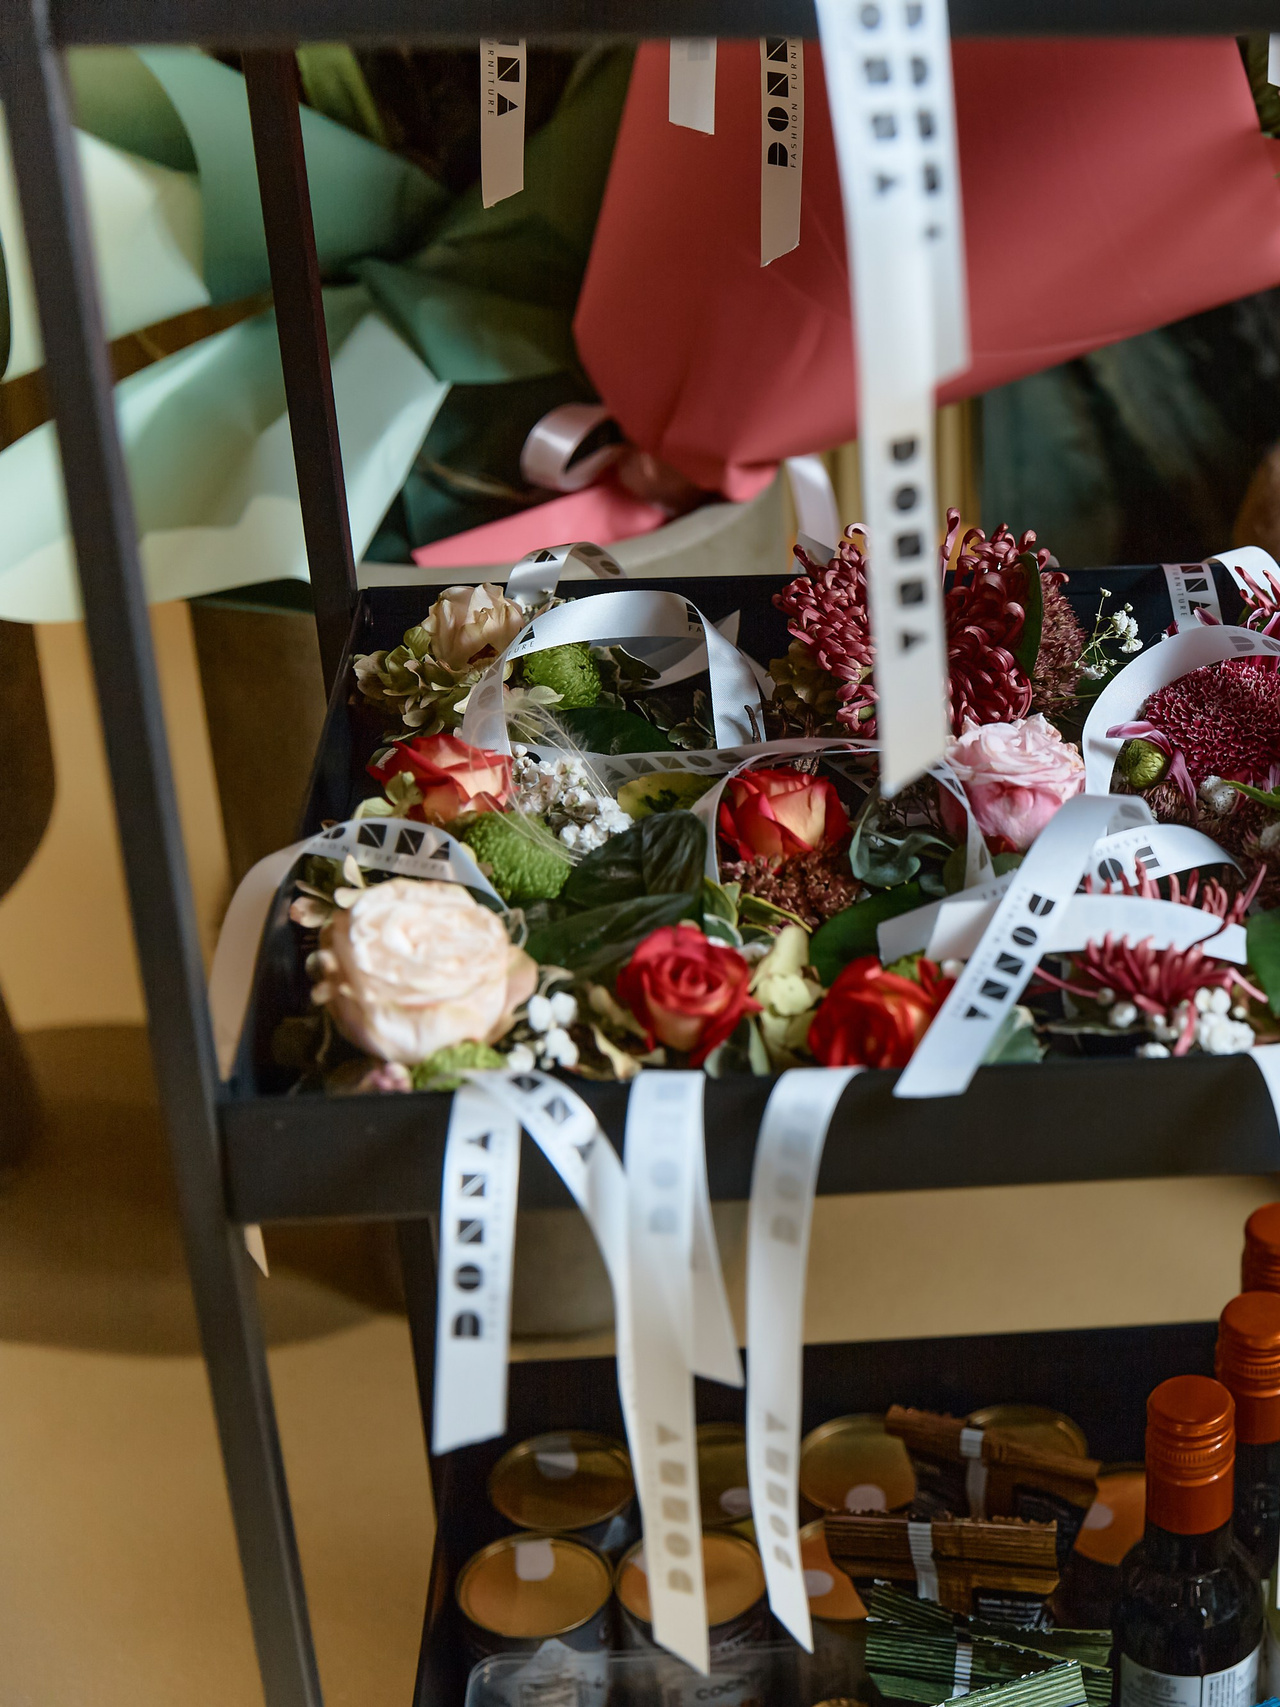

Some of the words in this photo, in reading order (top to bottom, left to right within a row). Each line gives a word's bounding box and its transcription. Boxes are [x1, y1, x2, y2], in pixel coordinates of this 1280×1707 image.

[765, 37, 789, 168] DONN
[790, 36, 798, 90] FURNI
[790, 103, 798, 169] FASHION
[963, 893, 1056, 1020] DONNA
[453, 1132, 491, 1339] DONNA
